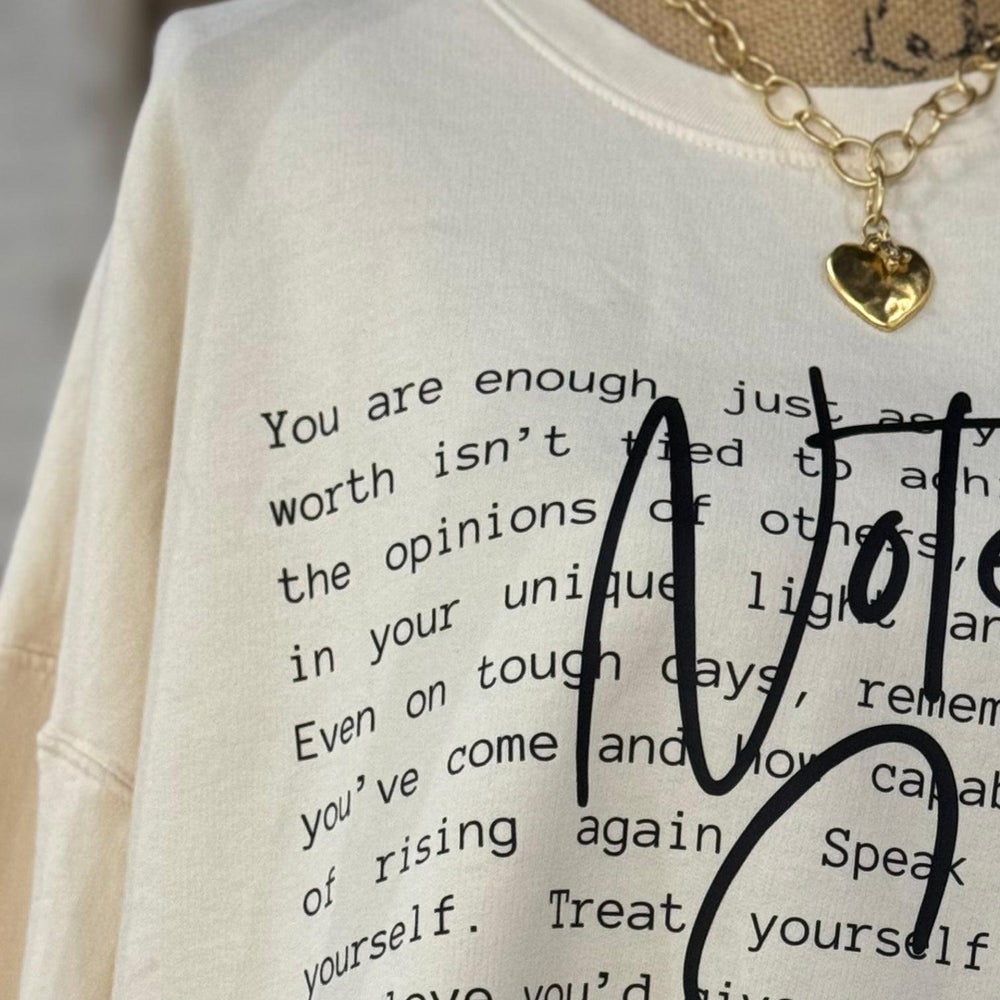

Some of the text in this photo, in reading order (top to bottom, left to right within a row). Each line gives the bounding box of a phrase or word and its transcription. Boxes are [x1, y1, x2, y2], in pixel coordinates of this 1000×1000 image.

[261, 405, 339, 448] You
[367, 376, 443, 421] are
[269, 463, 394, 526] worth
[794, 447, 852, 481] to
[278, 561, 351, 603] the
[385, 499, 597, 573] opinions
[650, 494, 711, 525] of
[290, 644, 334, 682] in
[370, 599, 460, 664] your
[504, 563, 679, 609] unique
[295, 706, 375, 761] Even
[406, 680, 446, 719] on
[478, 642, 620, 690] tough
[447, 732, 559, 775] come
[599, 726, 688, 766] and
[303, 866, 335, 916] of
[375, 817, 517, 884] rising
[576, 811, 722, 857] again
[821, 827, 967, 886] Speak
[550, 889, 686, 933] Treat
[748, 913, 989, 970] yourself
